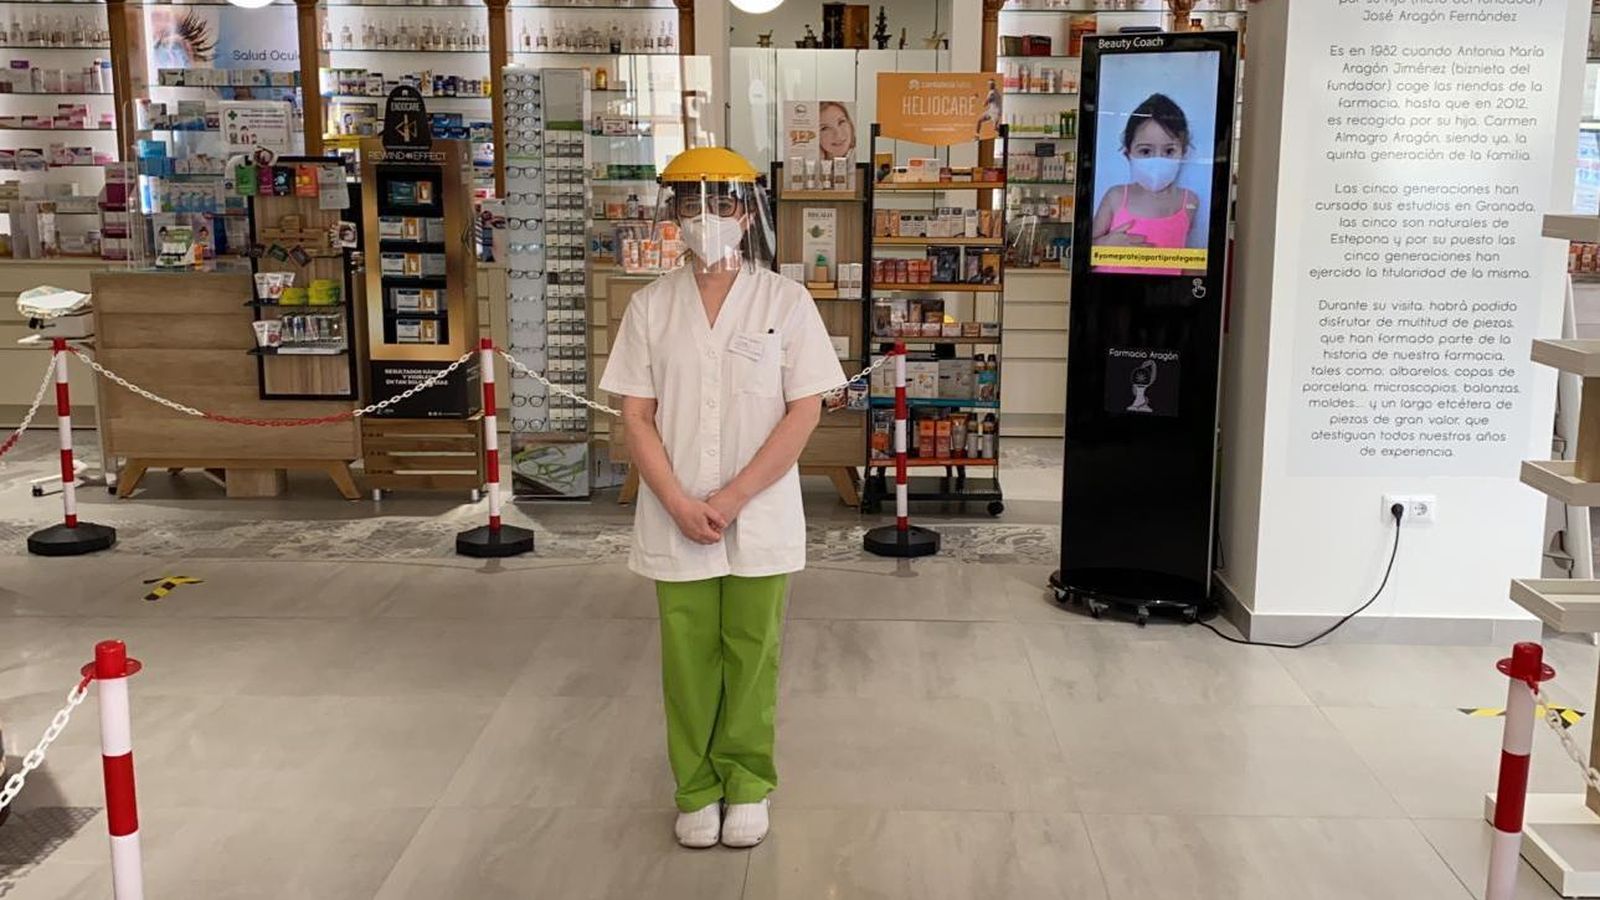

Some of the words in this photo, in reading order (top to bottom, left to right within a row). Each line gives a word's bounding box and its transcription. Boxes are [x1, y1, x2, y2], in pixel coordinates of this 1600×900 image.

[1363, 10, 1393, 21] José
[1399, 10, 1445, 24] Aragón
[1450, 10, 1517, 21] Fernández
[1098, 38, 1131, 50] Beauty
[1133, 36, 1164, 48] Coach
[233, 49, 267, 61] Salud
[1330, 46, 1344, 56] Es
[1349, 47, 1365, 56] en
[1402, 46, 1452, 56] cuando
[1458, 46, 1505, 57] Antonia
[1510, 46, 1544, 57] María
[1343, 63, 1388, 76] Aragón
[1394, 63, 1446, 74] Jiménez
[1452, 63, 1505, 77] (biznieto
[1510, 63, 1530, 74] del
[1397, 82, 1429, 94] coge
[1434, 81, 1452, 91] las
[1457, 81, 1503, 91] riendas
[1509, 81, 1526, 92] de
[1531, 81, 1542, 92] la
[902, 95, 977, 116] HELIOCARE
[1406, 98, 1440, 108] hasta
[1445, 100, 1470, 111] que
[1475, 100, 1491, 108] en
[1328, 118, 1341, 126] es
[1347, 117, 1405, 129] recogida
[1410, 118, 1432, 129] por
[1437, 118, 1451, 126] su
[1484, 117, 1537, 126] Carmen
[1335, 132, 1387, 145] Almagro
[1446, 133, 1488, 143] siendo
[1516, 134, 1526, 144] la
[1327, 149, 1365, 162] quinta
[1371, 150, 1444, 163] generación
[1449, 150, 1465, 160] de
[1471, 150, 1481, 161] la
[1335, 184, 1357, 194] Las
[1362, 184, 1398, 194] cinco
[1403, 184, 1490, 197] generaciones
[1495, 185, 1518, 195] han
[1315, 202, 1367, 211] cursado
[1373, 202, 1392, 211] sus
[1397, 202, 1450, 211] estudios
[1455, 203, 1471, 211] en
[1339, 218, 1356, 227] las
[1362, 217, 1397, 227] cinco
[1403, 218, 1424, 227] son
[1429, 218, 1487, 228] naturales
[1493, 219, 1509, 228] de
[1331, 234, 1389, 247] Estepona
[1394, 236, 1401, 247] y
[1406, 236, 1427, 247] por
[1433, 236, 1446, 245] su
[1451, 235, 1493, 248] puesto
[1499, 235, 1515, 245] las
[1344, 251, 1379, 261] cinco
[1385, 251, 1471, 264] generaciones
[1476, 252, 1500, 261] han
[1309, 268, 1361, 281] ejercido
[1366, 268, 1377, 278] la
[1383, 268, 1445, 278] titularidad
[1450, 268, 1467, 278] de
[1472, 268, 1483, 278] la
[1319, 299, 1368, 310] Durante
[1373, 301, 1386, 310] su
[1430, 300, 1467, 311] habrá
[1472, 301, 1517, 314] podido
[1319, 318, 1370, 327] disfrutar
[1377, 318, 1392, 327] de
[1398, 318, 1447, 327] multitud
[1452, 318, 1468, 327] de
[1320, 335, 1344, 346] que
[1350, 335, 1373, 343] han
[1378, 335, 1434, 344] formado
[1439, 334, 1473, 347] parte
[1479, 335, 1495, 344] de
[1500, 335, 1511, 344] la
[1108, 348, 1148, 359] Farmacia
[1149, 350, 1179, 362] Aragón
[1323, 351, 1367, 360] historia
[1372, 351, 1388, 360] de
[1394, 350, 1439, 360] nuestra
[1312, 366, 1340, 375] tales
[1455, 367, 1493, 379] copas
[1499, 368, 1515, 377] de
[1370, 400, 1377, 411] y
[1381, 400, 1396, 409] un
[1401, 399, 1432, 412] largo
[1437, 400, 1491, 409] etcétera
[1496, 400, 1512, 410] de
[1330, 414, 1368, 427] piezas
[1373, 416, 1389, 425] de
[1395, 416, 1423, 427] gran
[1465, 417, 1489, 428] que
[1311, 430, 1375, 443] atestiguan
[1381, 431, 1414, 441] todos
[1420, 431, 1471, 442] nuestros
[1476, 432, 1506, 442] años
[1360, 447, 1376, 456] de
